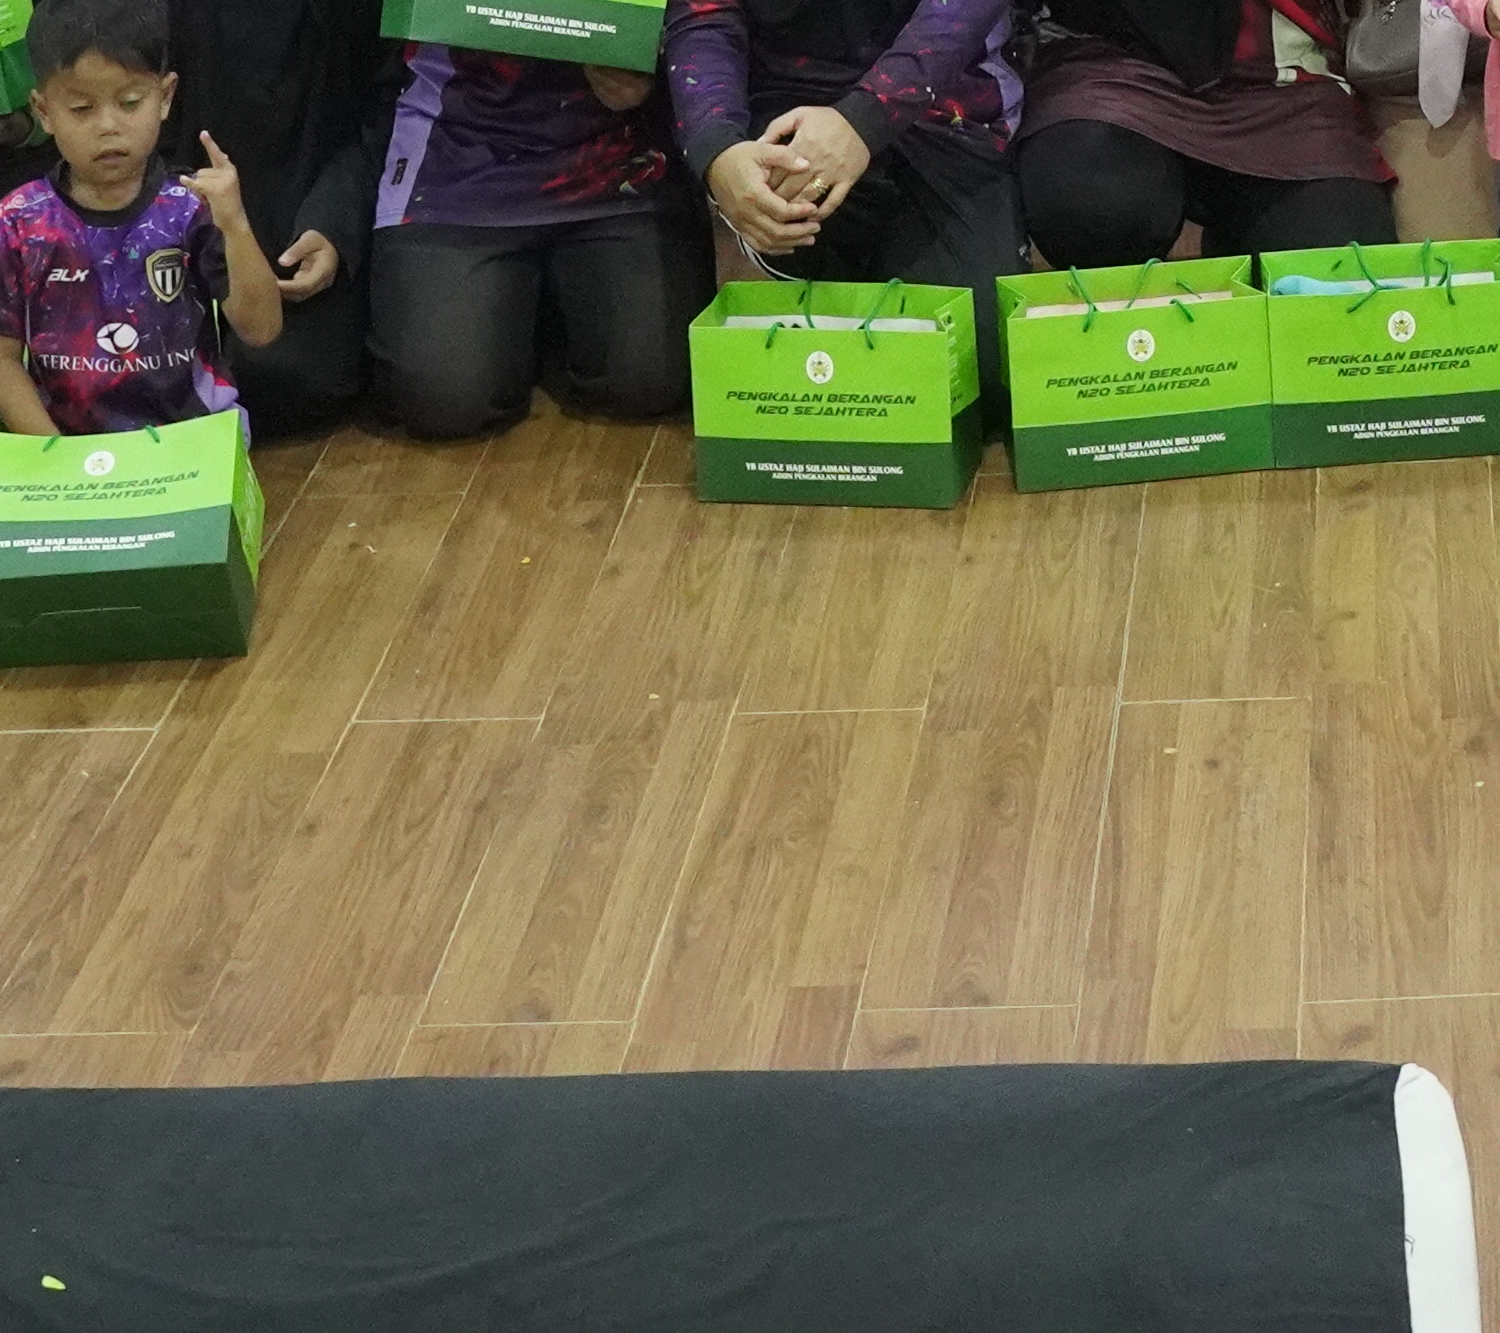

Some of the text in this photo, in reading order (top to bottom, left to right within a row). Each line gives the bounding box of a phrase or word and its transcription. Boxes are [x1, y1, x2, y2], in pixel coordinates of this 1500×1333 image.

[40, 353, 161, 373] TERENGGANU
[1306, 342, 1498, 366] PENGKALAN BERANGAN
[1045, 361, 1238, 389] PENGKALAN BERANGAN
[1374, 358, 1470, 375] SEJAHTERA
[1114, 376, 1211, 395] SEJAHTERA
[725, 390, 916, 404] PENGKALAN BERANGAN
[791, 405, 888, 417] SEJAHTERA
